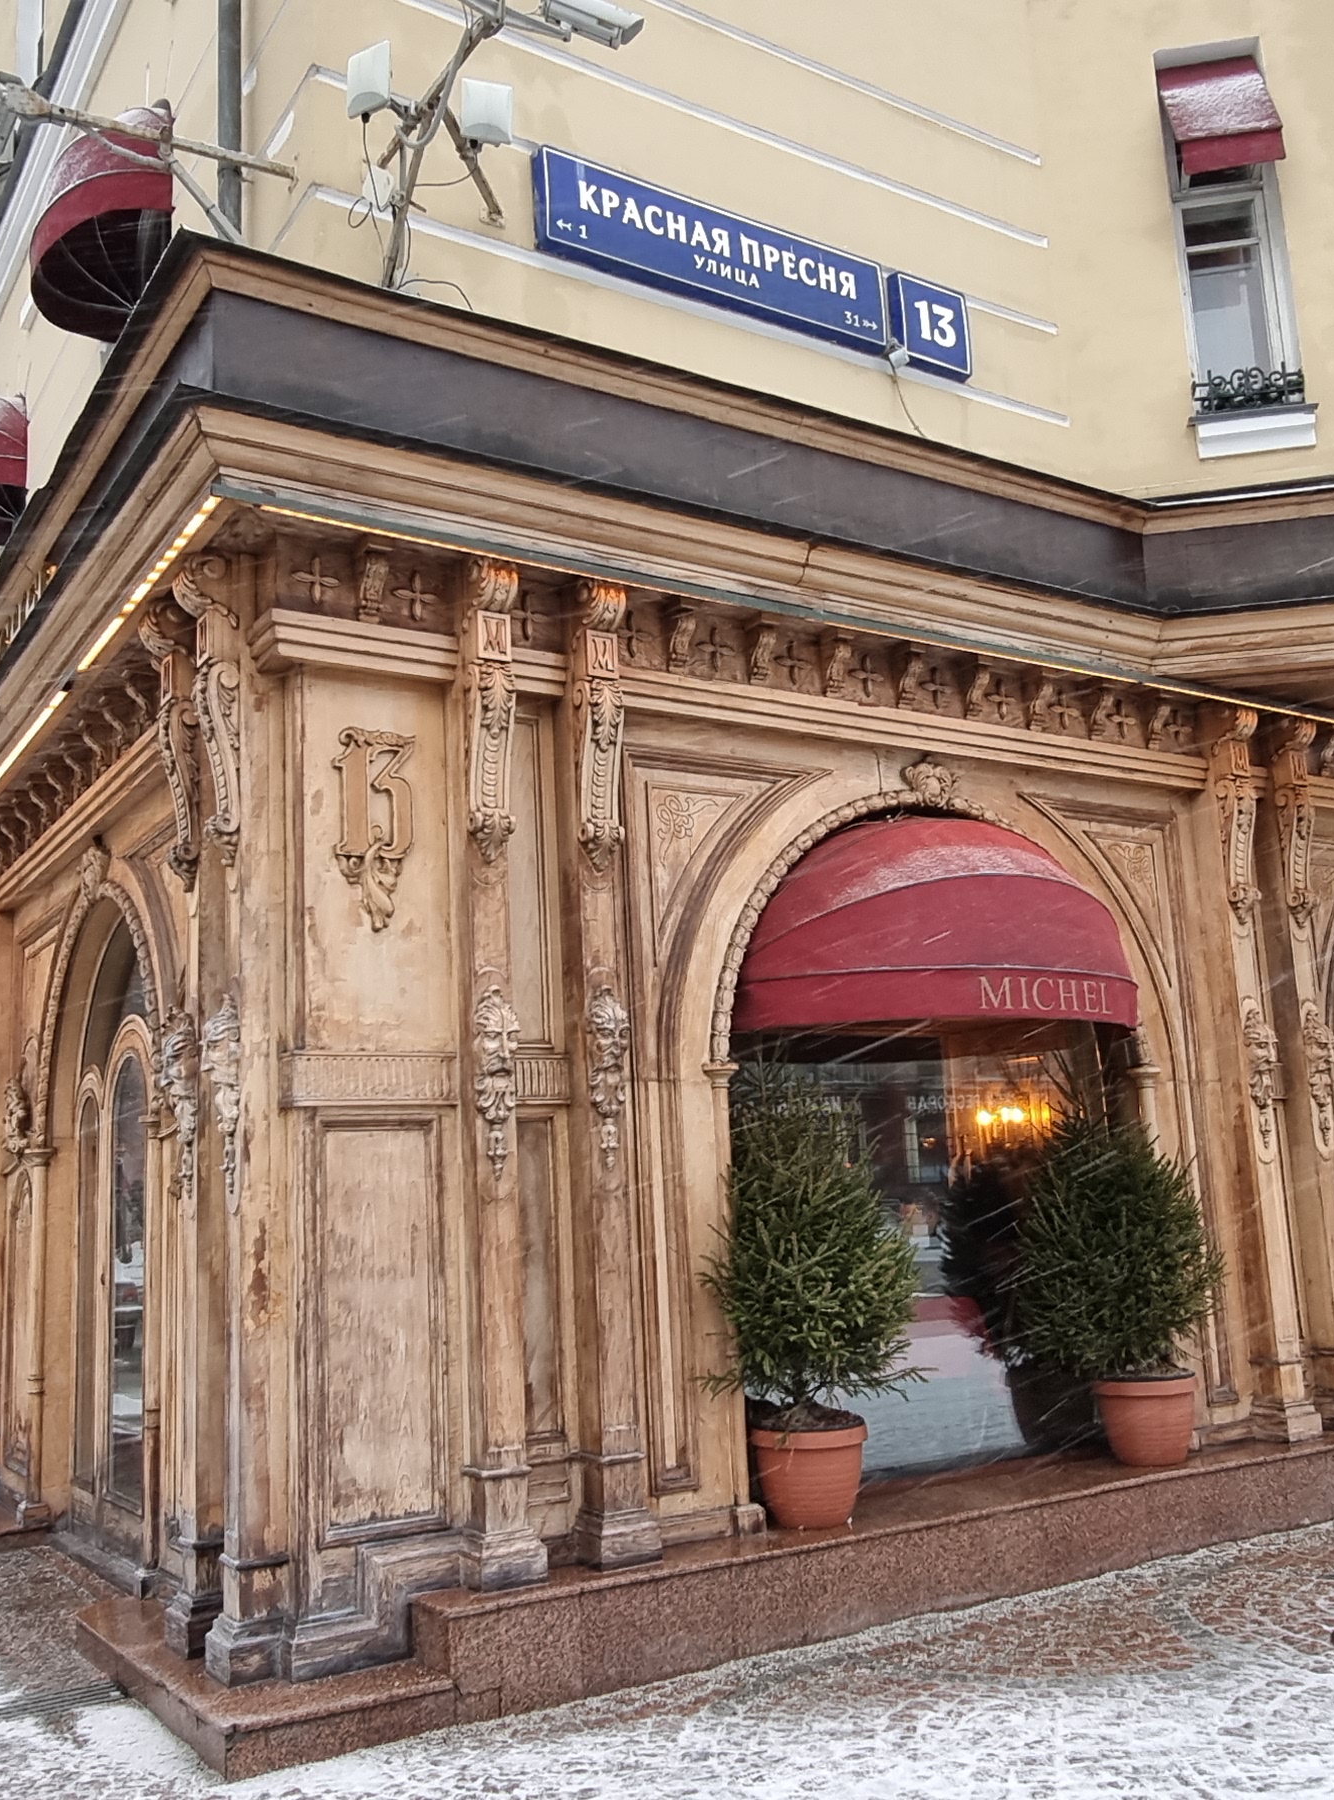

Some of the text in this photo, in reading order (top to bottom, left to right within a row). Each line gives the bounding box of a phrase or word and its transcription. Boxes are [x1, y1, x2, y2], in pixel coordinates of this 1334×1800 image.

[578, 225, 588, 239] 1
[578, 180, 857, 300] КРАСНАЯ ПРЕСНЯ
[693, 254, 760, 289] УЛИЦА
[844, 311, 860, 327] 31
[914, 300, 957, 348] 13
[331, 738, 415, 859] 13
[979, 976, 1112, 1014] MICHEL
